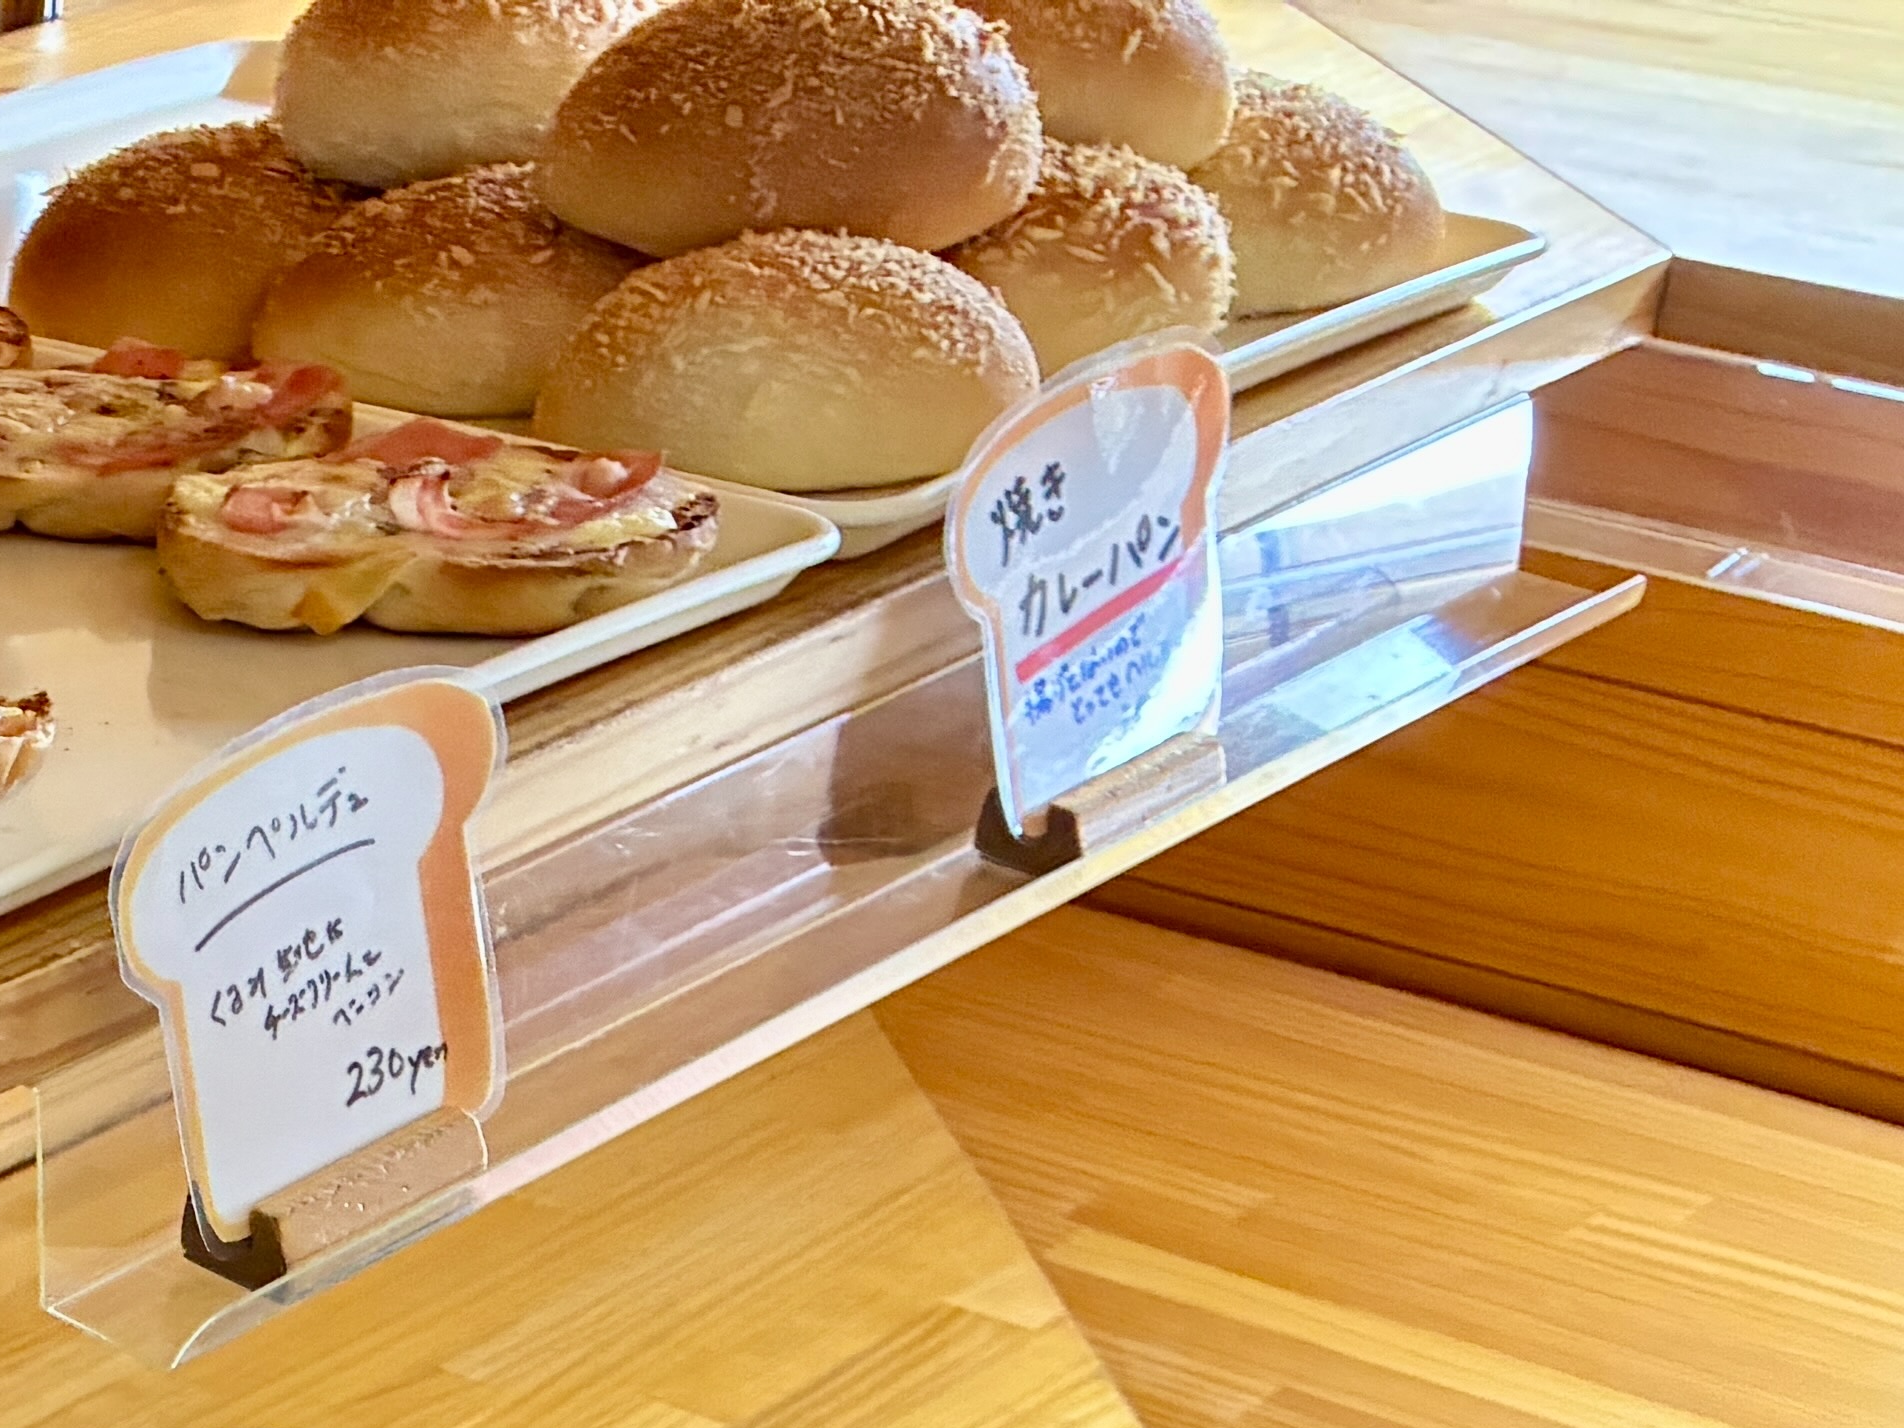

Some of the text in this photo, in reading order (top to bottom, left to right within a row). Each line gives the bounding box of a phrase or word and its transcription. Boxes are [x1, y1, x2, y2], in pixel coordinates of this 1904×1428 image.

[991, 462, 1065, 566] 焼き
[1019, 514, 1180, 637] カレーパン
[346, 1041, 448, 1107] 230yen
